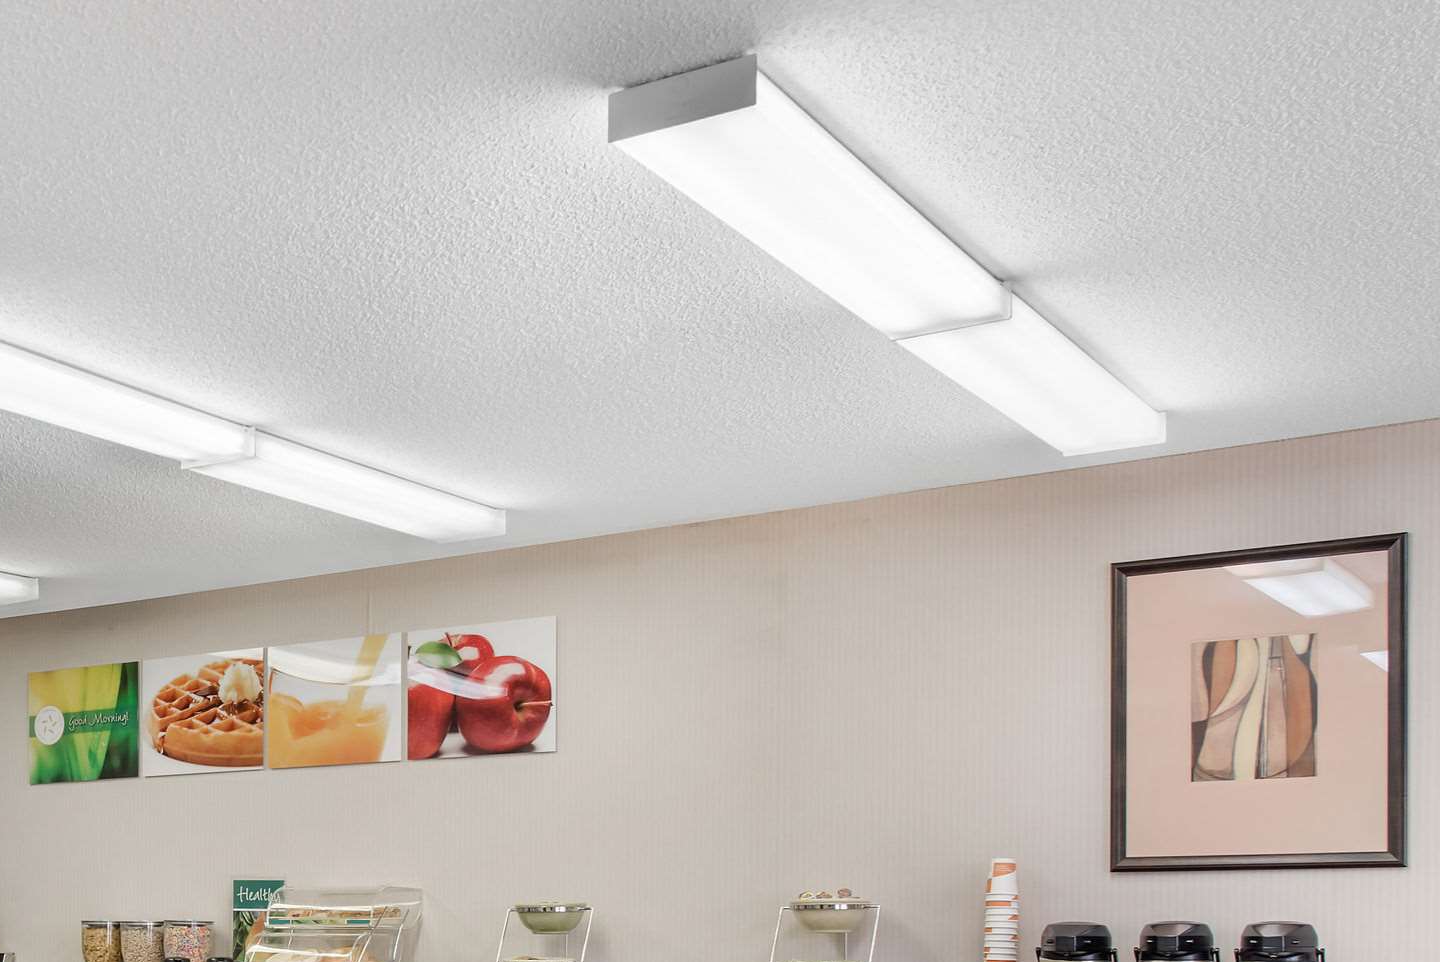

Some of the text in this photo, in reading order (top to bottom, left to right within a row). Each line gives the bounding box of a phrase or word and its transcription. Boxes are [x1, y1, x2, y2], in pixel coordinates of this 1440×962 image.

[68, 710, 129, 731] Good Morning!
[236, 885, 281, 903] Healthy
